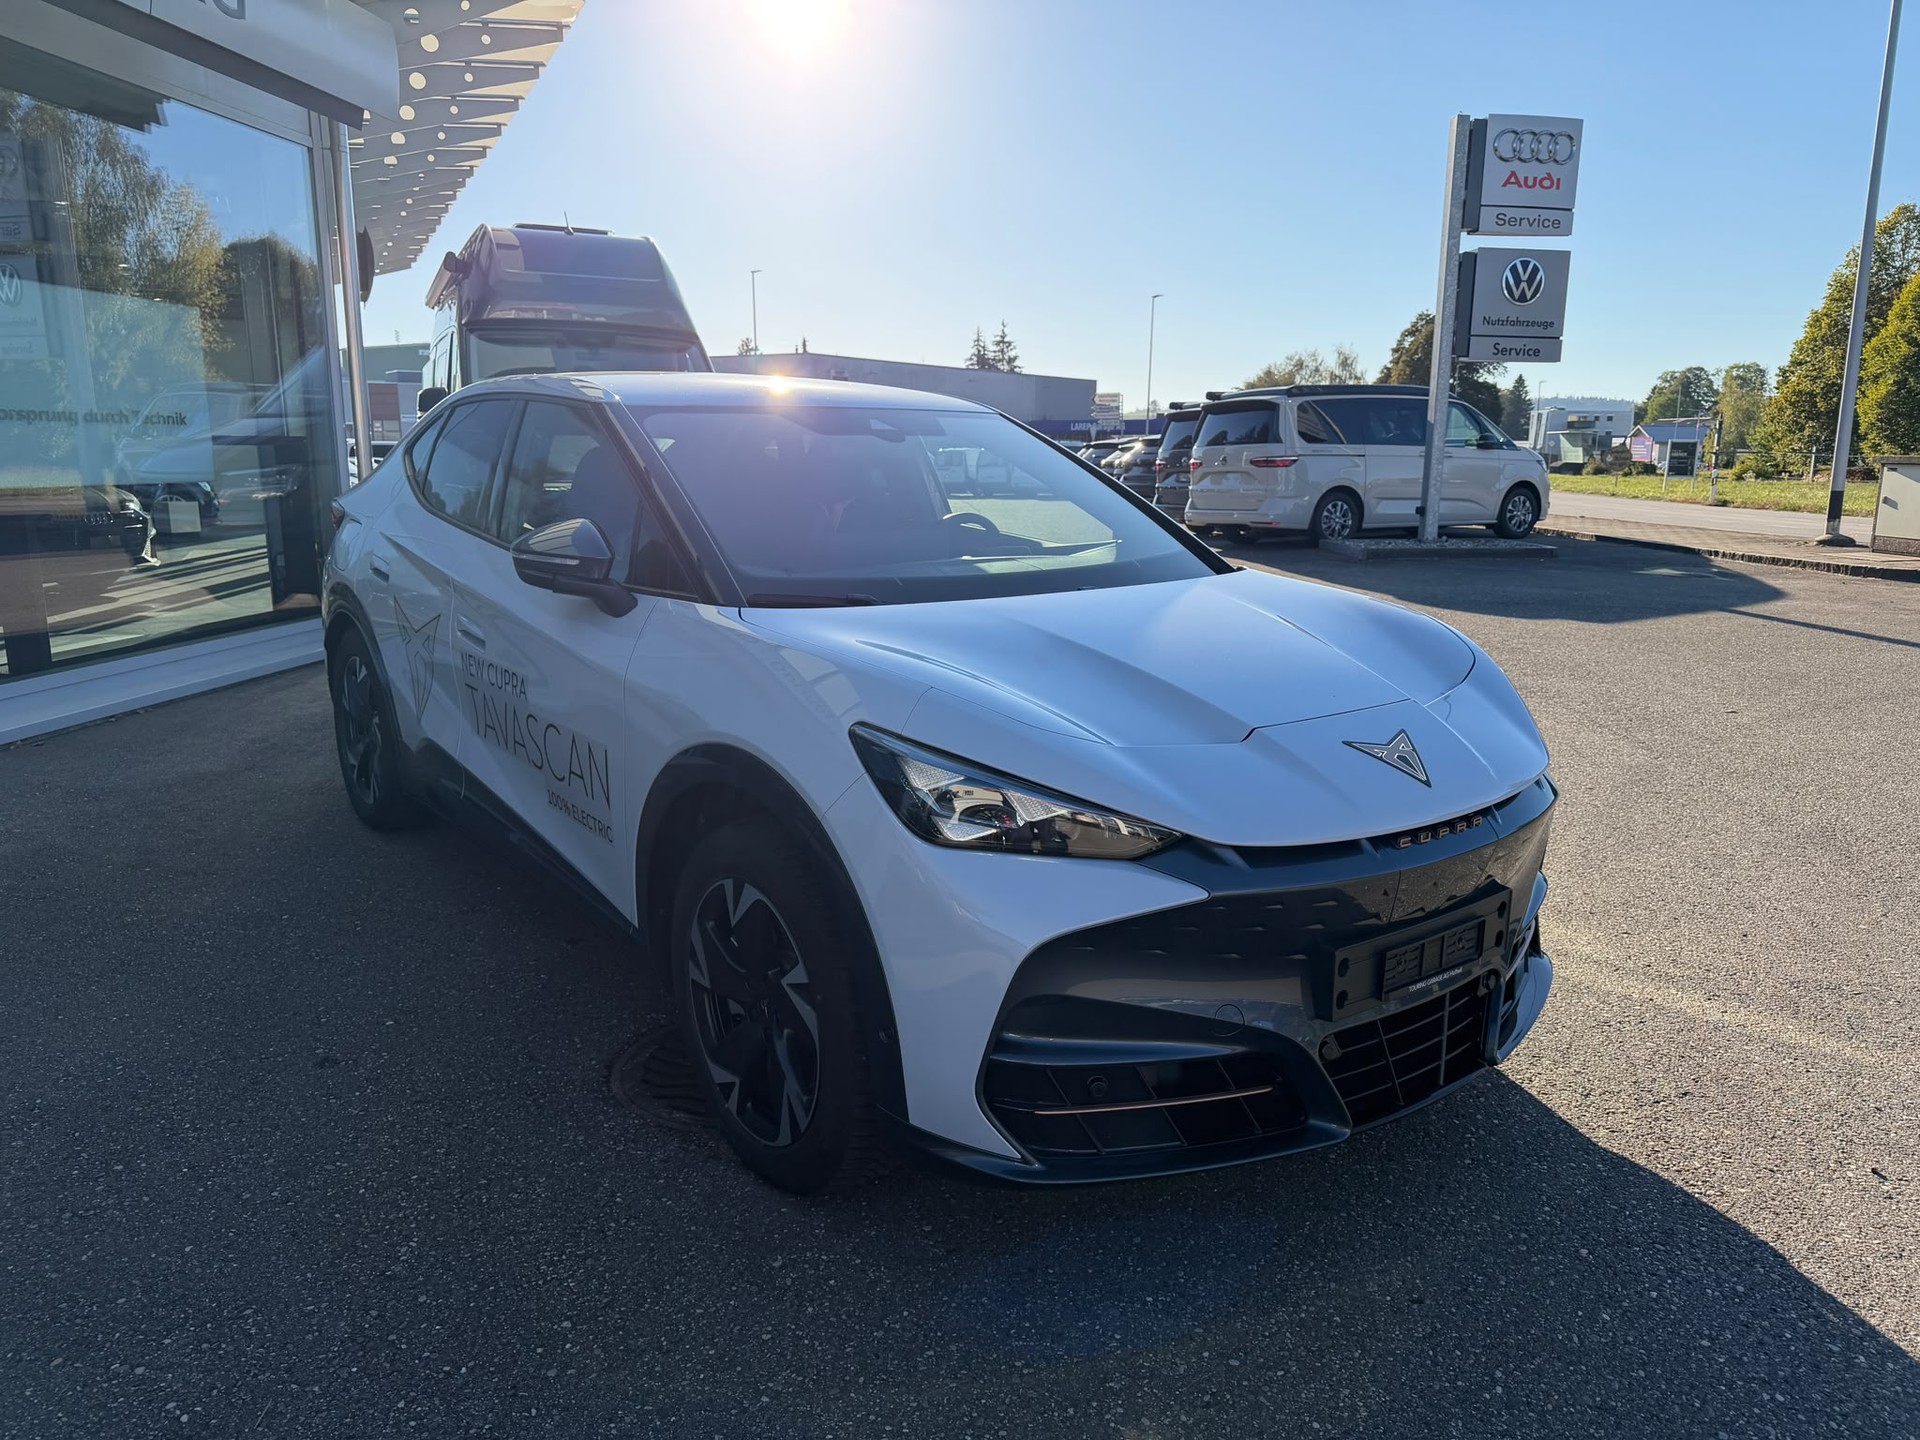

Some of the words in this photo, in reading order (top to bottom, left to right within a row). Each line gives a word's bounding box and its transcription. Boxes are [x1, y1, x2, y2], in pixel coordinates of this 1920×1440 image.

[1501, 169, 1561, 191] Audi
[1495, 212, 1561, 229] Service
[1482, 315, 1555, 330] Nutzfahrzeuge
[1492, 342, 1541, 357] Service
[0, 409, 78, 426] orsprung
[83, 409, 129, 424] durch
[460, 652, 484, 680] NEW
[487, 662, 528, 701] CUPRA
[465, 683, 611, 809] TAVASCAN
[547, 789, 571, 816] 100%
[572, 804, 614, 843] ELECTRIC
[1398, 816, 1483, 848] CUPRA
